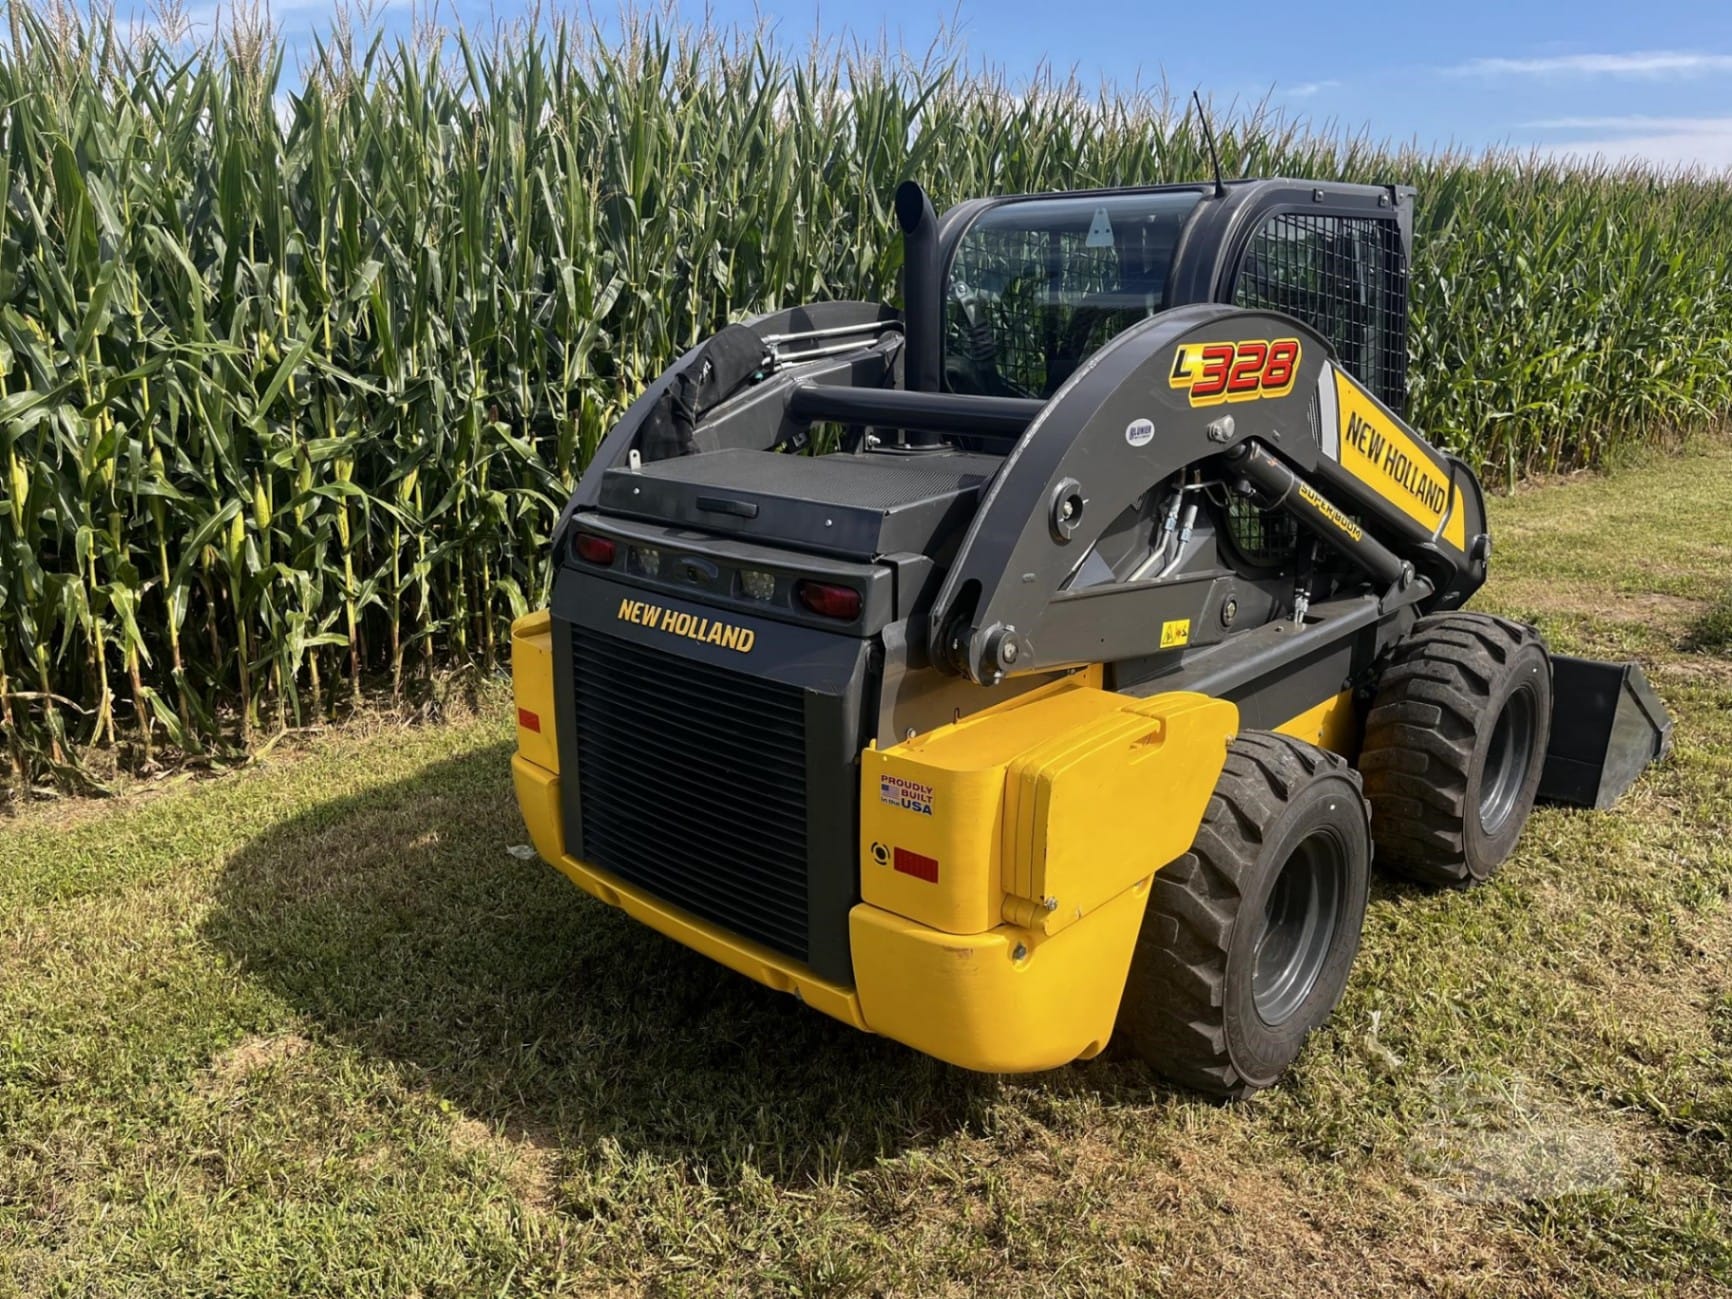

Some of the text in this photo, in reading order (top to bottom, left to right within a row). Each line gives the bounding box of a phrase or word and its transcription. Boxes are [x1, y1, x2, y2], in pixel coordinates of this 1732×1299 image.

[1171, 340, 1300, 400] L328
[1346, 411, 1446, 515] NEW HOLLAND
[617, 598, 756, 653] NEW HOLLAND
[881, 775, 933, 794] PROUDLY
[901, 789, 933, 803] BUILT
[901, 798, 932, 815] USA
